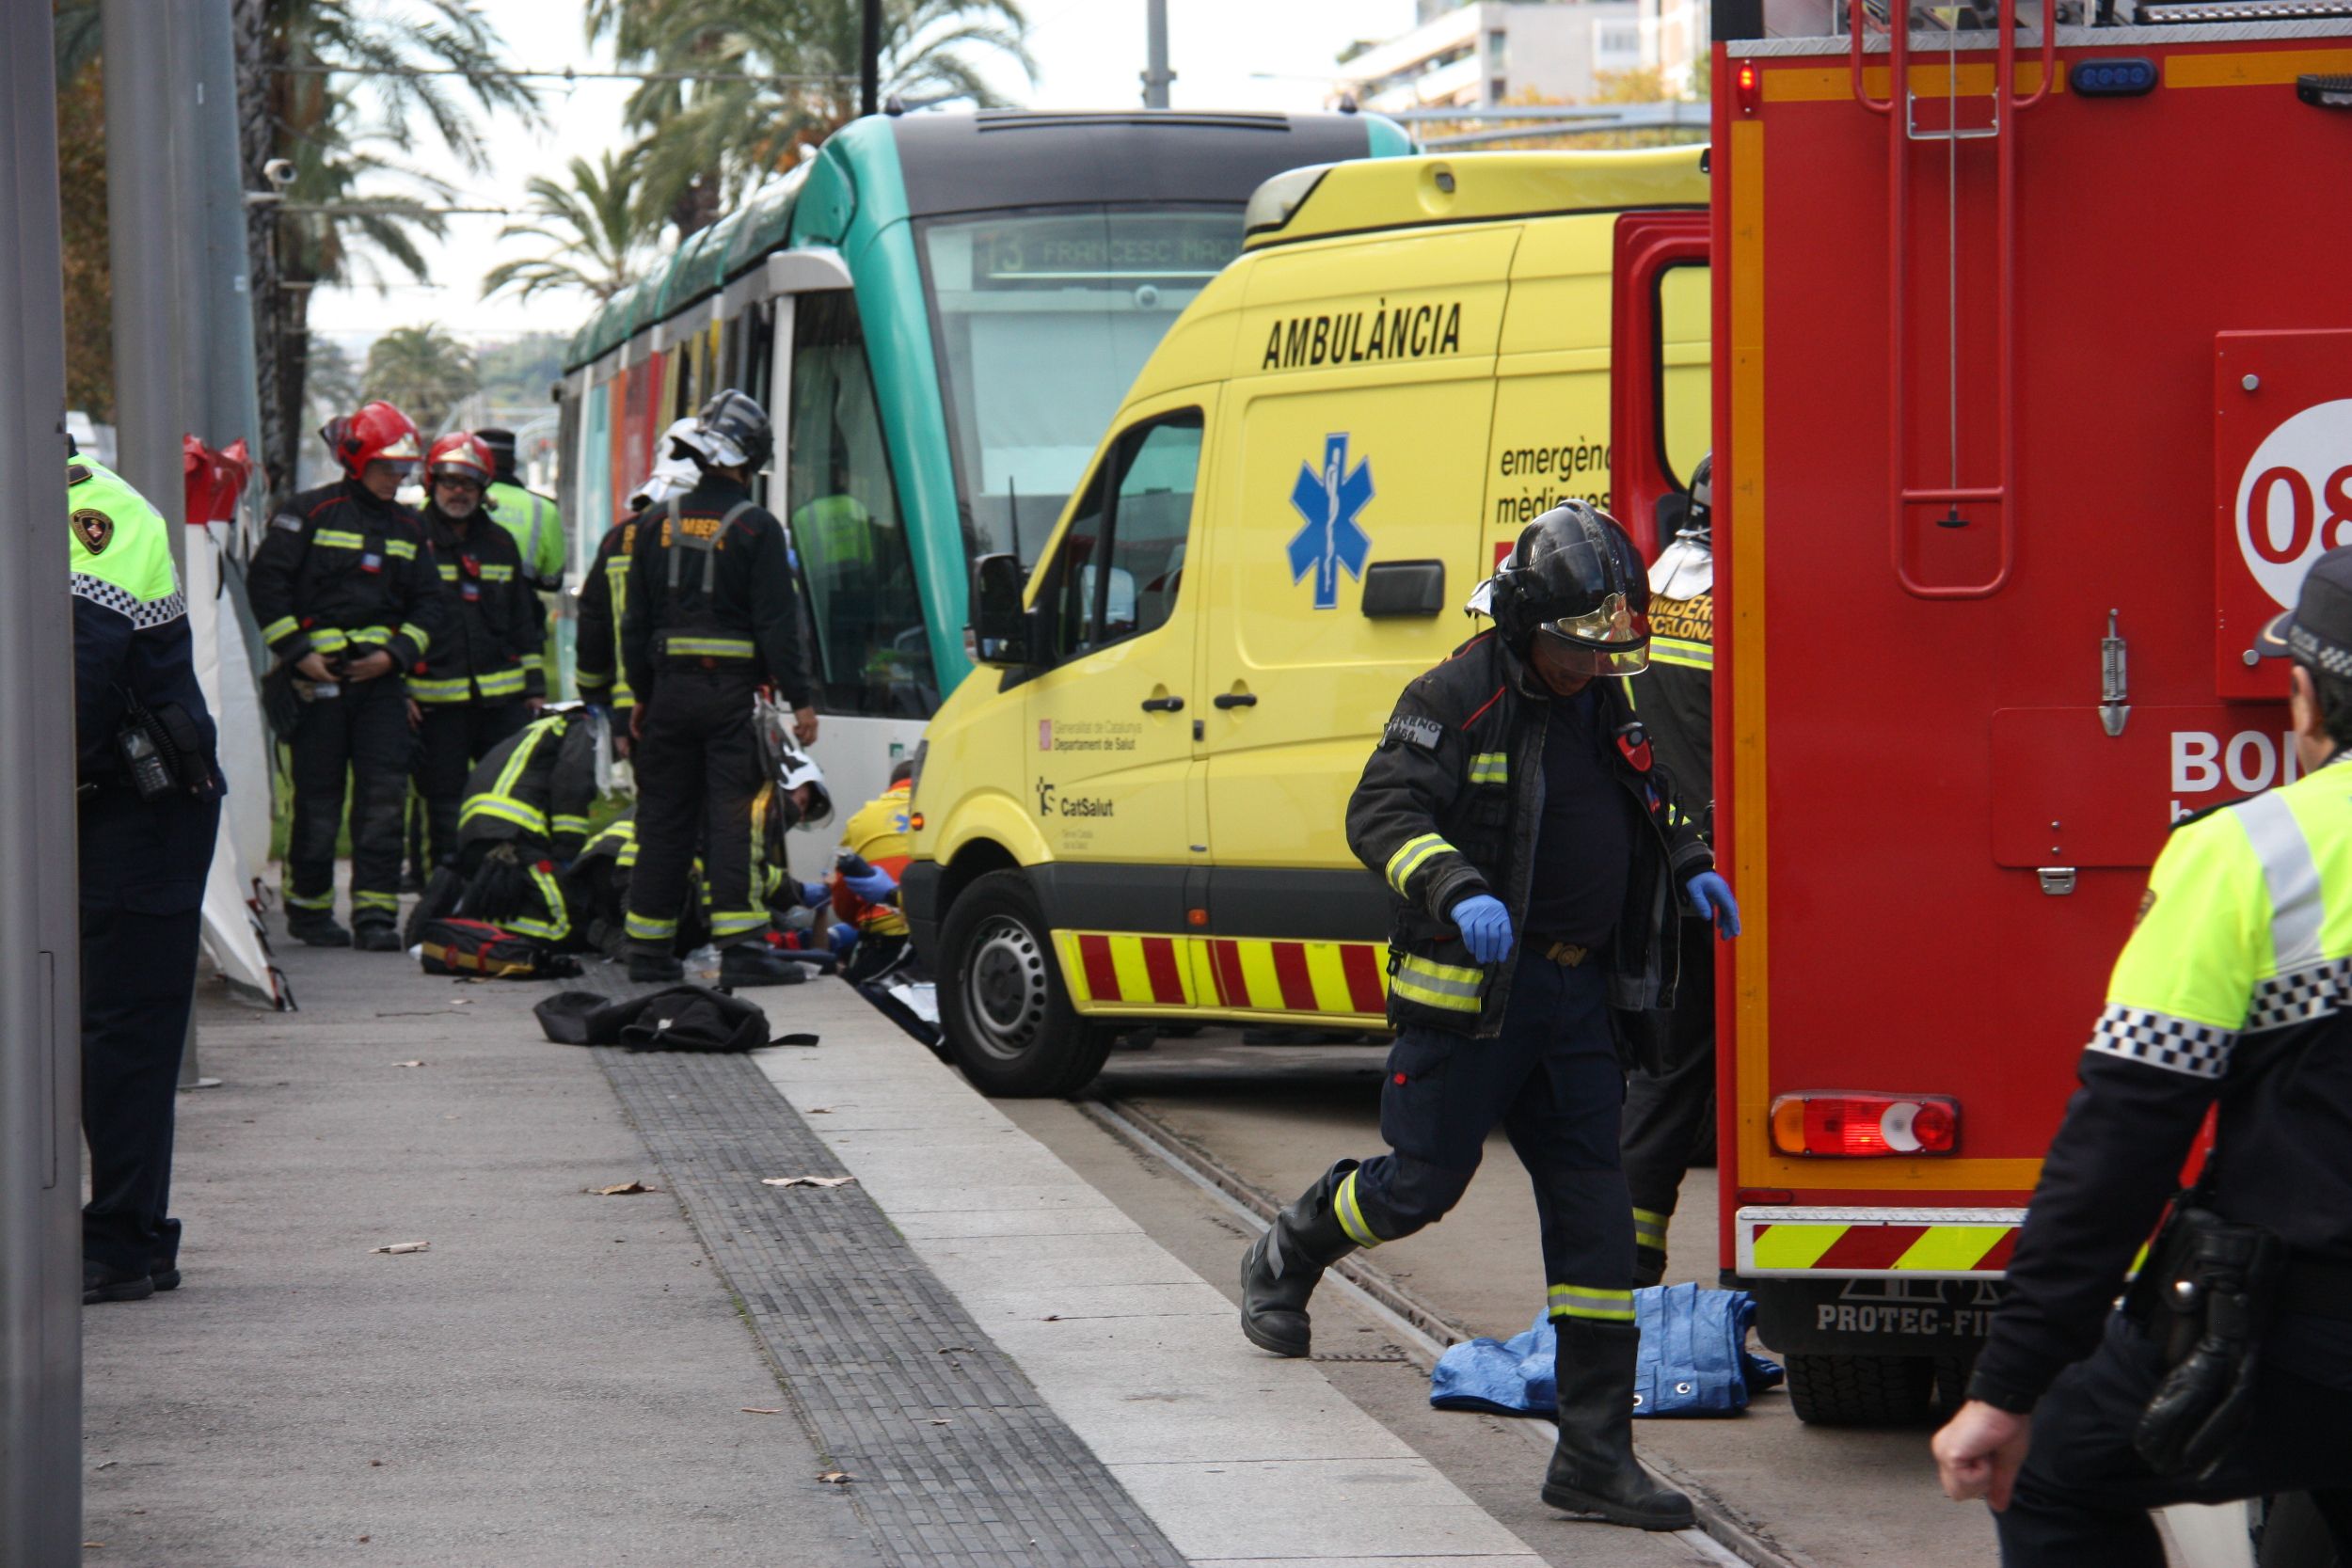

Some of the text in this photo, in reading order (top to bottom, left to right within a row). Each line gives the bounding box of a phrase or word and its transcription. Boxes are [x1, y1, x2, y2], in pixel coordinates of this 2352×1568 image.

[1043, 239, 1170, 262] FRANCESC
[1262, 297, 1461, 371] AMBULÀNCIA
[1054, 736, 1136, 752] Departament de Salut
[2170, 730, 2298, 793] BO
[1060, 797, 1114, 817] CatSalut
[1817, 1304, 1994, 1337] PROTEC-FI
